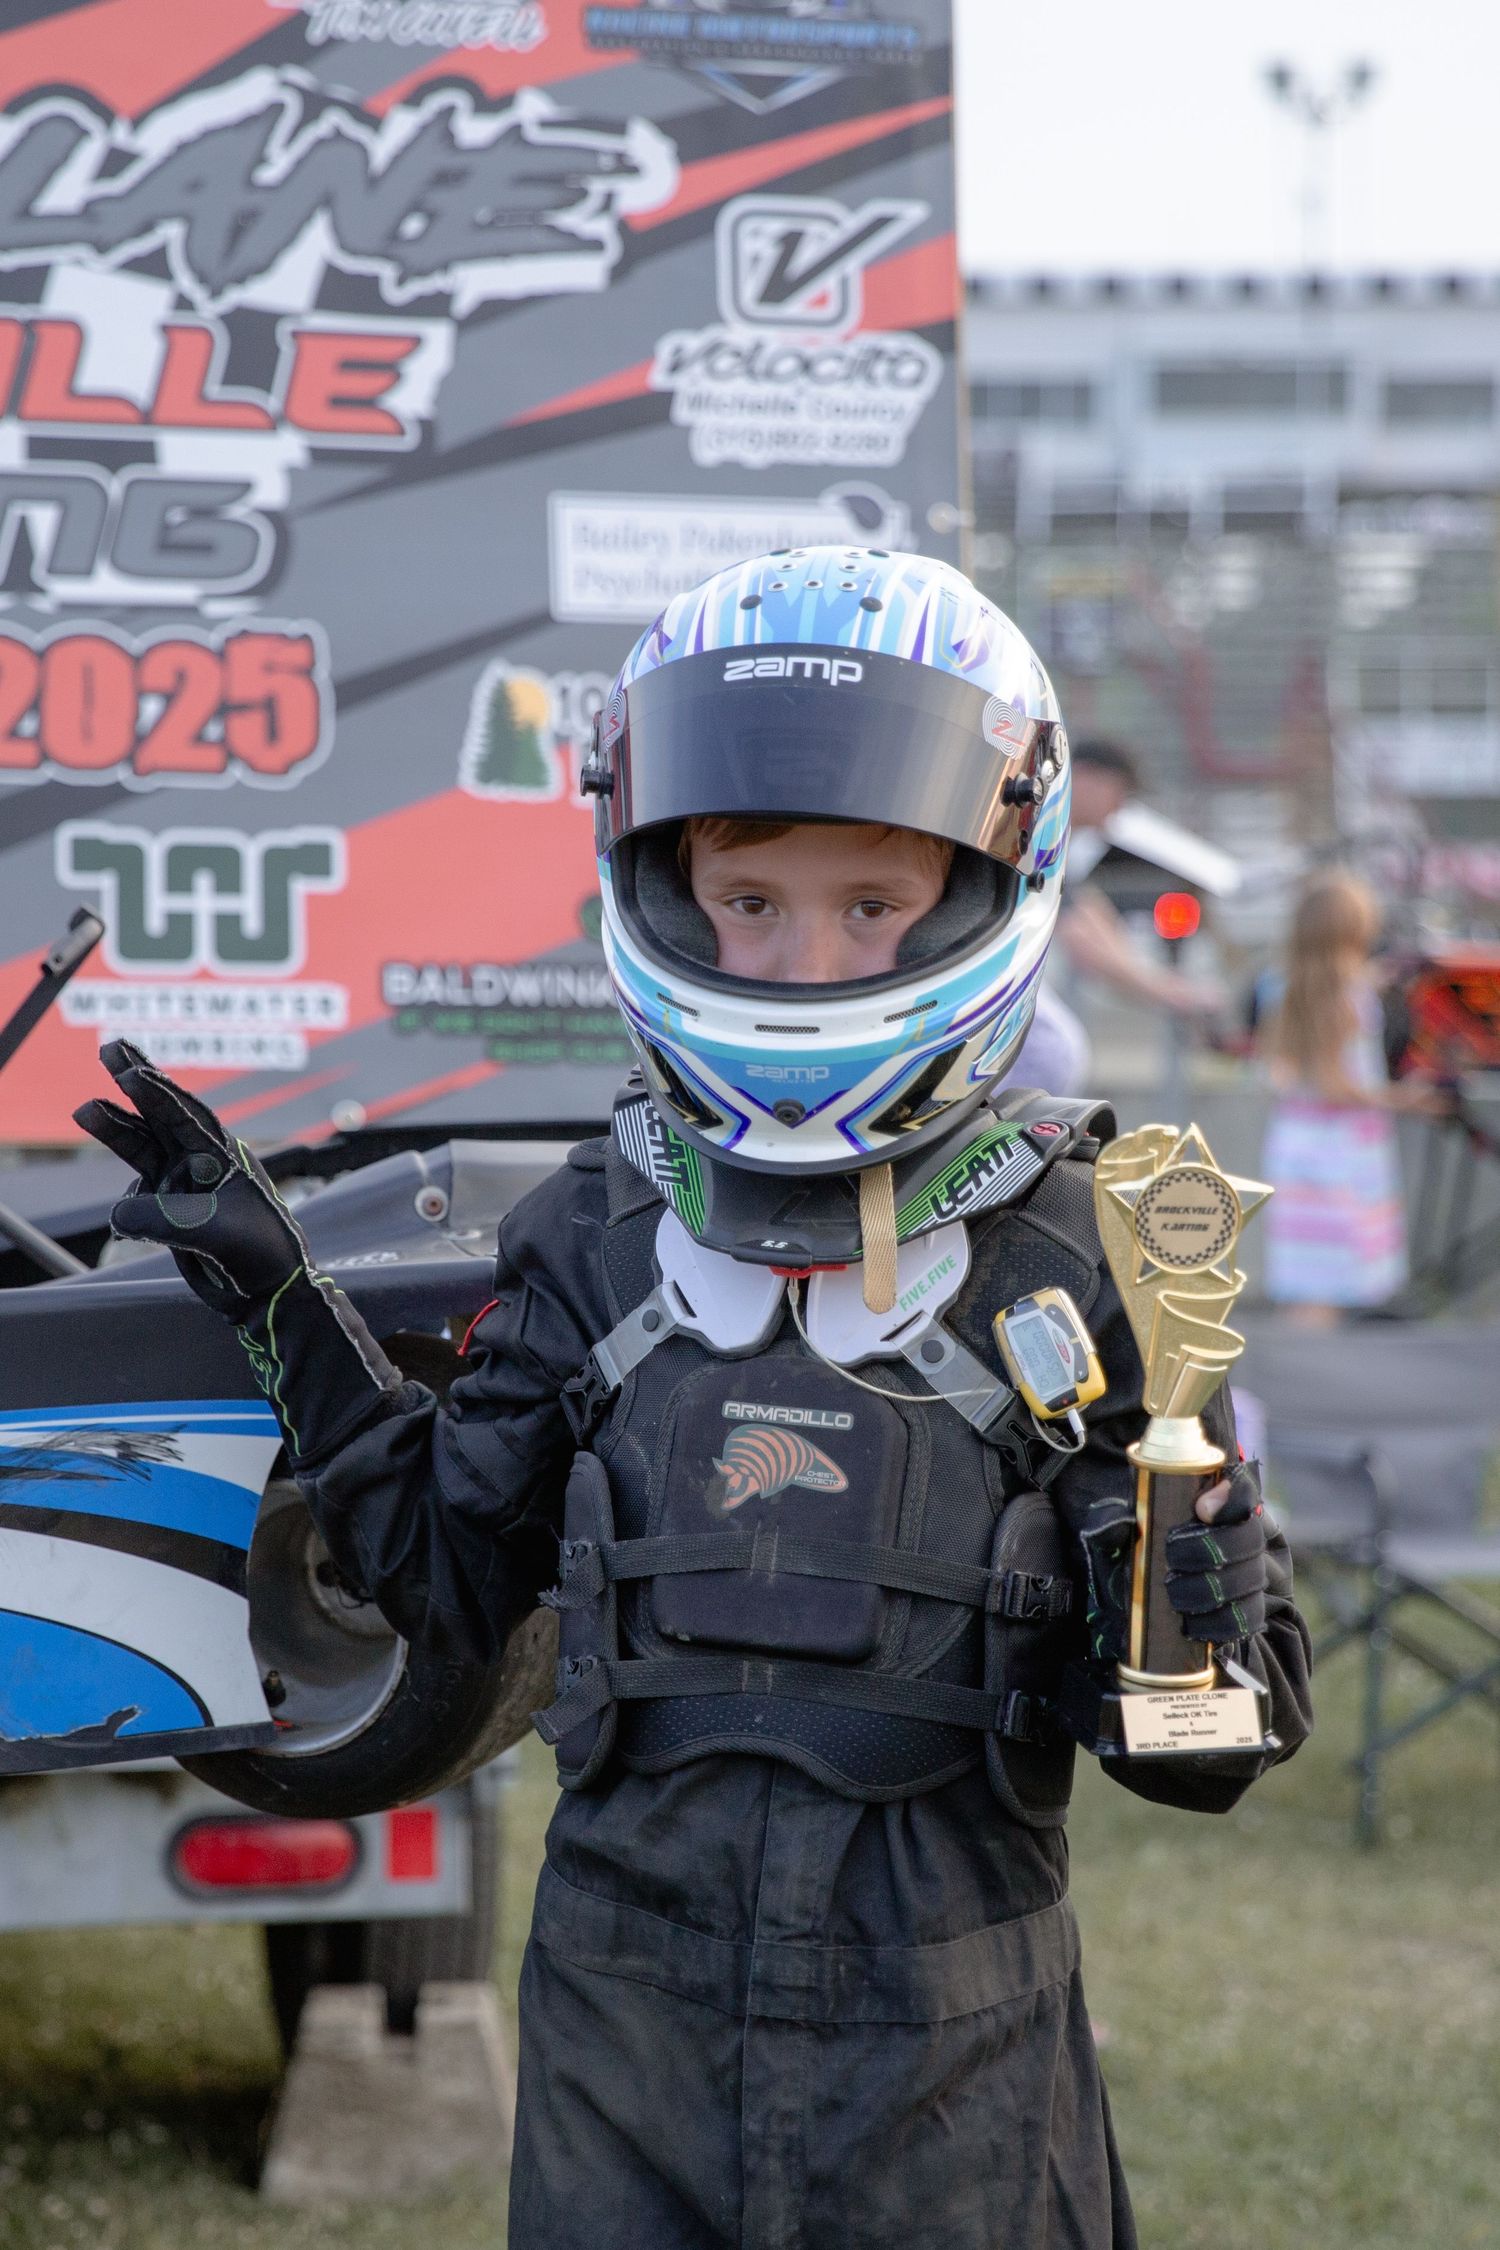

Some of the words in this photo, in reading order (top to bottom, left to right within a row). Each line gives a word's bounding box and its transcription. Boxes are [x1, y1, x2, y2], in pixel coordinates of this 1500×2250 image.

[723, 656, 863, 686] zamp
[745, 1064, 830, 1083] zamp
[1154, 1206, 1219, 1215] BROCKVILLE
[898, 1254, 957, 1312] FIVE.FIVE
[724, 1402, 852, 1428] ARMADILLO
[1147, 1695, 1175, 1704] GREEN
[1176, 1694, 1200, 1702] PLATE
[1201, 1692, 1229, 1701] CLONE
[1204, 1710, 1218, 1718] Tire
[1168, 1730, 1189, 1738] Blade
[1190, 1729, 1217, 1737] Runner
[1136, 1742, 1151, 1750] 3RD
[1152, 1741, 1179, 1749] PLACE
[1235, 1736, 1253, 1744] 2025
